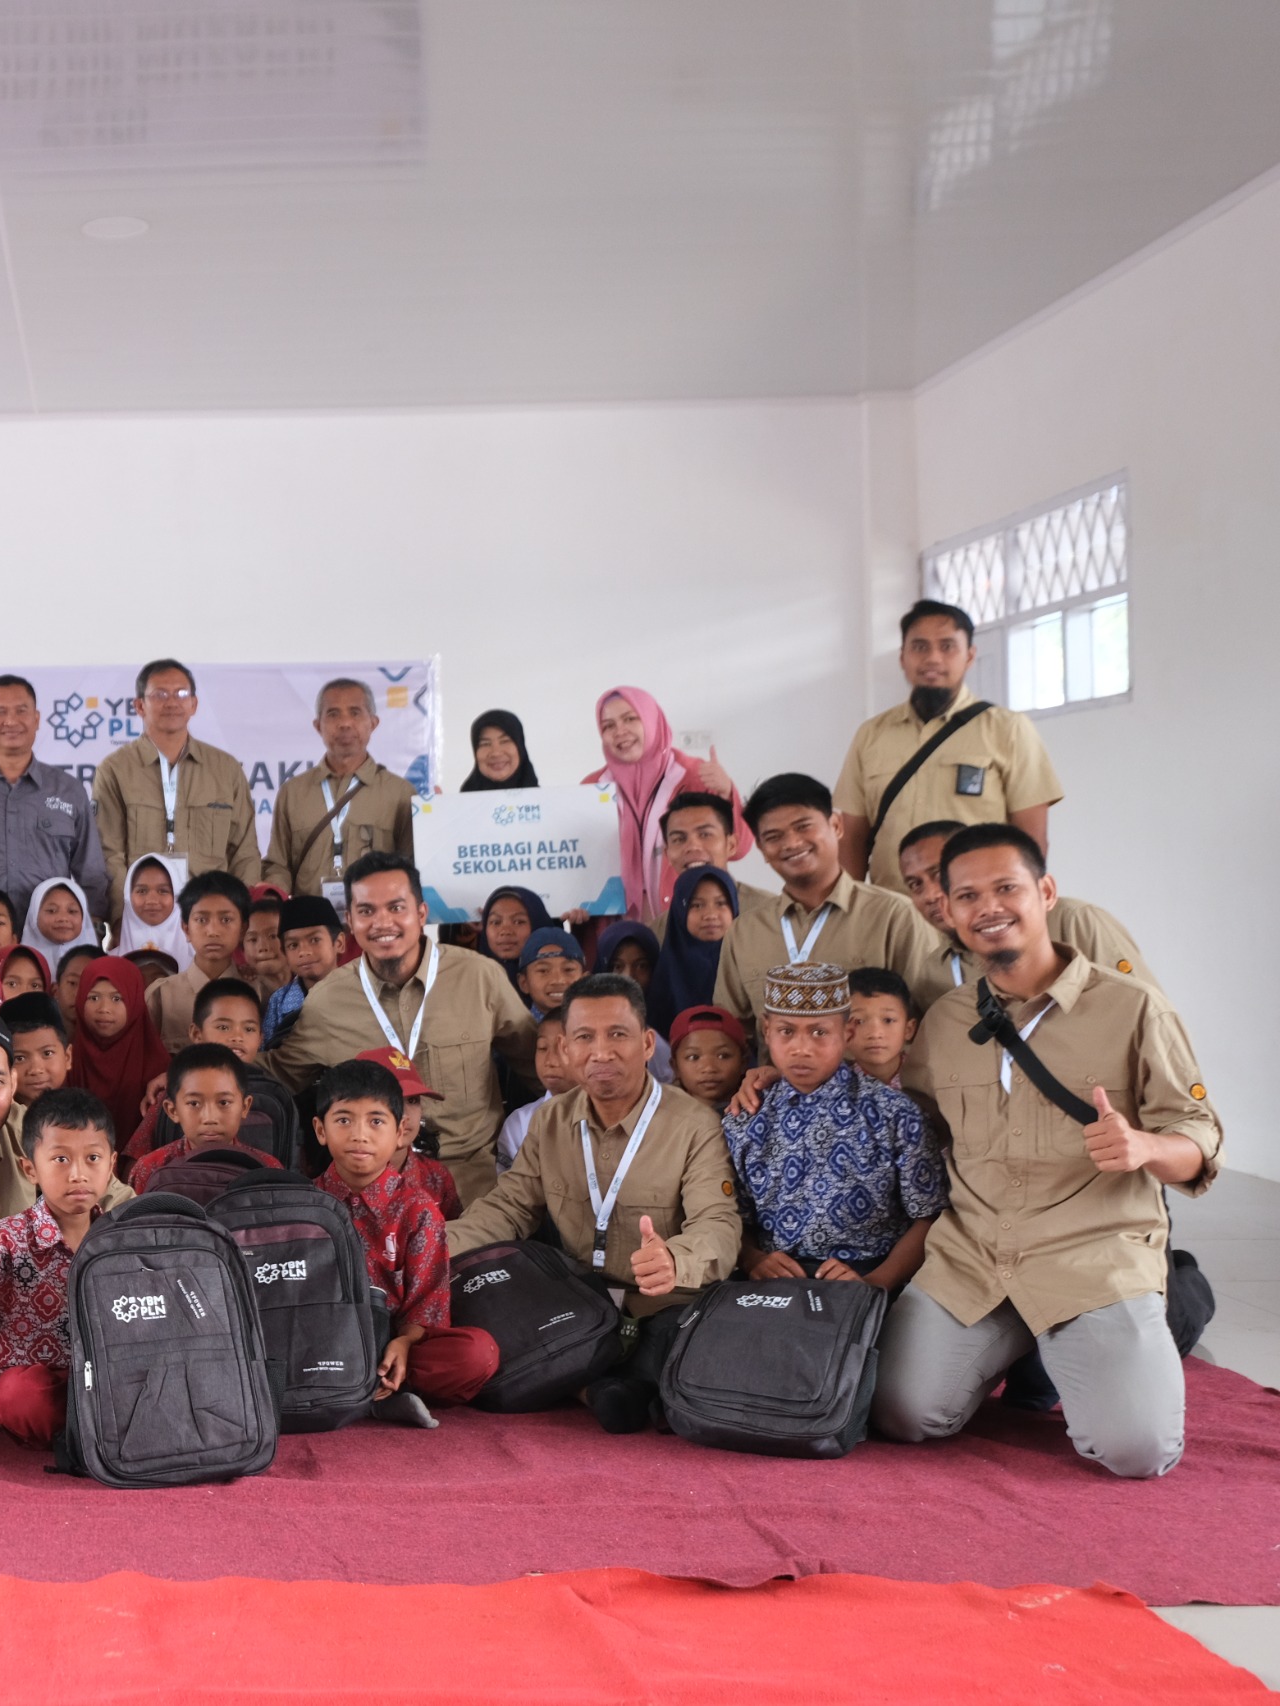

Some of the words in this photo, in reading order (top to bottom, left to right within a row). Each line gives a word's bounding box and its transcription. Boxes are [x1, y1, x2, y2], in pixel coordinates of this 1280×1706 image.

[109, 718, 144, 737] PL
[516, 804, 540, 812] YBM
[518, 812, 540, 821] PLN
[457, 841, 532, 859] BERBAGI
[537, 838, 580, 855] ALAT
[452, 858, 532, 875] SEKOLAH
[536, 855, 587, 870] CERIA
[279, 1260, 306, 1269] YBM
[281, 1269, 307, 1277] PLN
[137, 1295, 165, 1306] YBM
[140, 1305, 167, 1316] PLN
